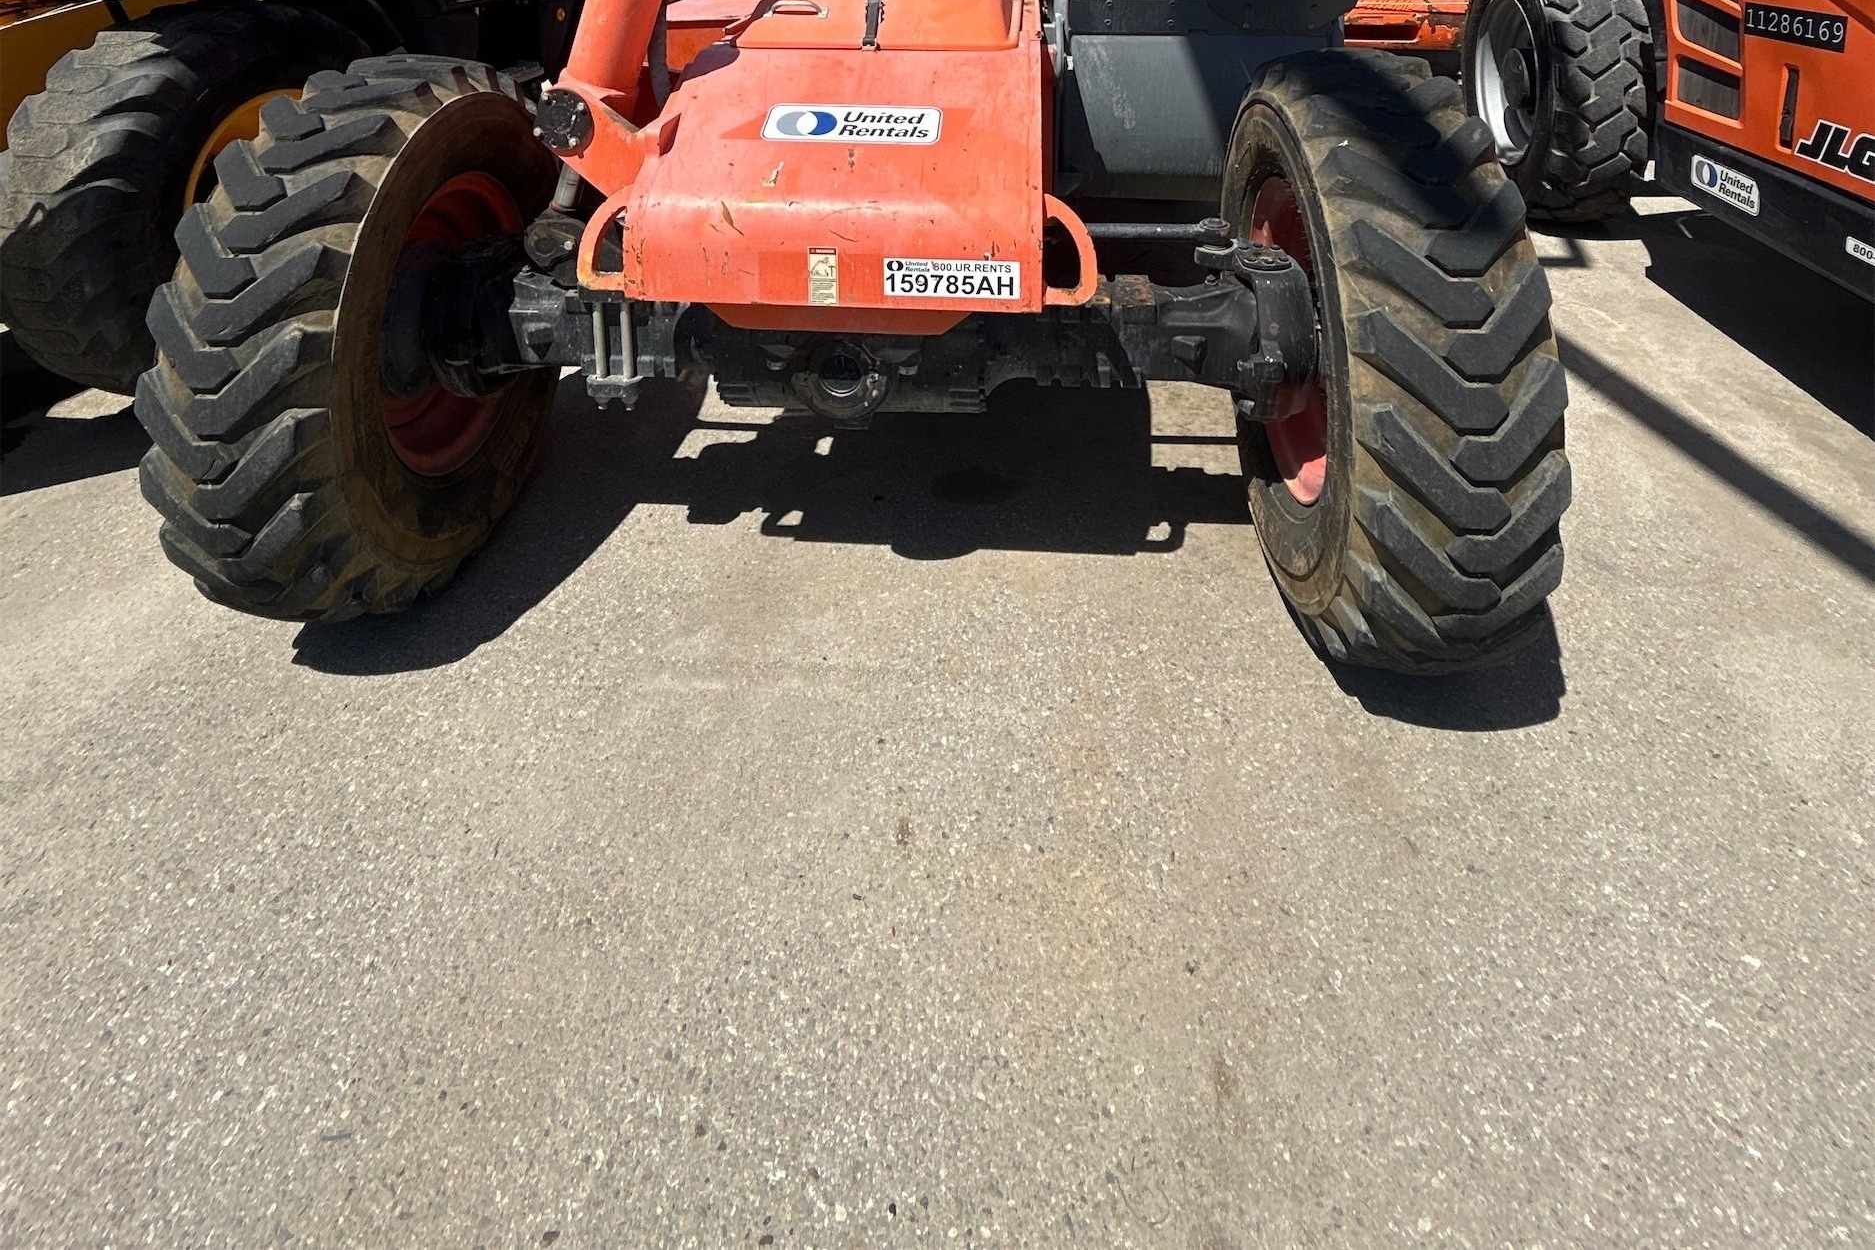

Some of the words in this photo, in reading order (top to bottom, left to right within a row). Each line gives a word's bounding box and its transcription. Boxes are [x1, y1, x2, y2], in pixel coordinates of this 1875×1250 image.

[1746, 8, 1844, 44] 11286169
[838, 124, 930, 138] Rentals
[843, 111, 926, 125] United
[1794, 118, 1875, 184] JLG
[1720, 169, 1754, 195] United
[1718, 182, 1756, 209] Rentals
[886, 273, 1014, 296] 159785AH
